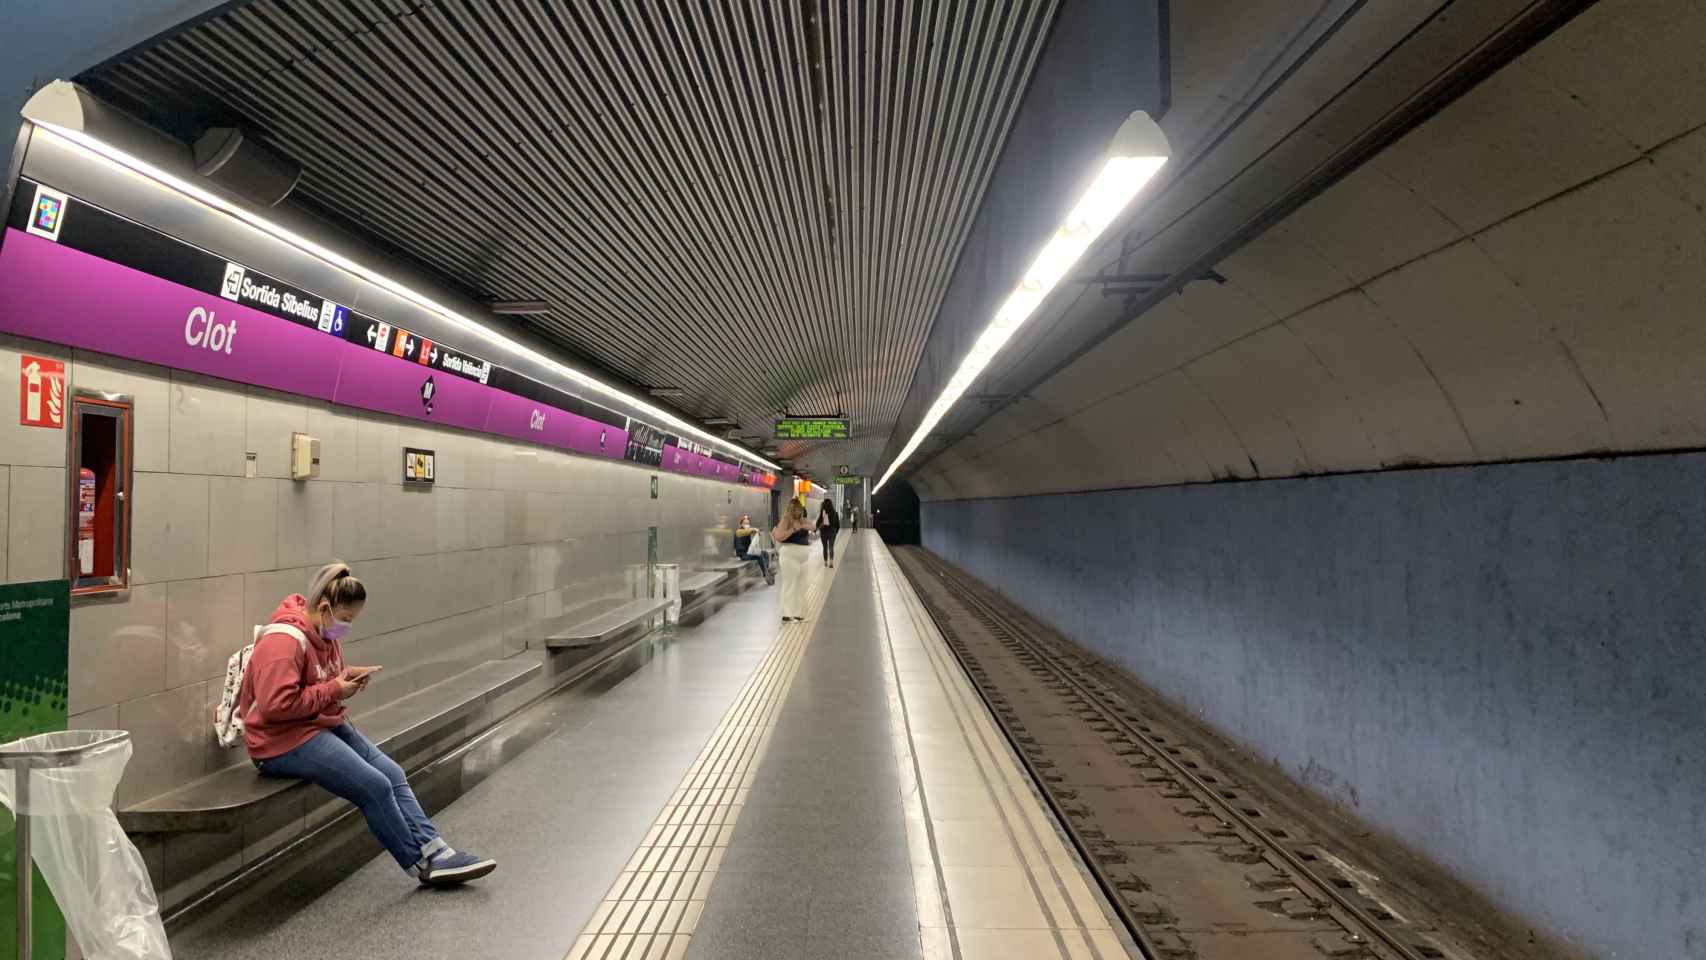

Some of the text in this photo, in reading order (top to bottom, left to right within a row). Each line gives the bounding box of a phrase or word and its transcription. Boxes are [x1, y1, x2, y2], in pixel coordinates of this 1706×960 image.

[241, 277, 319, 322] Sortida Sibelius
[185, 306, 237, 355] Clot
[530, 408, 546, 431] Clot
